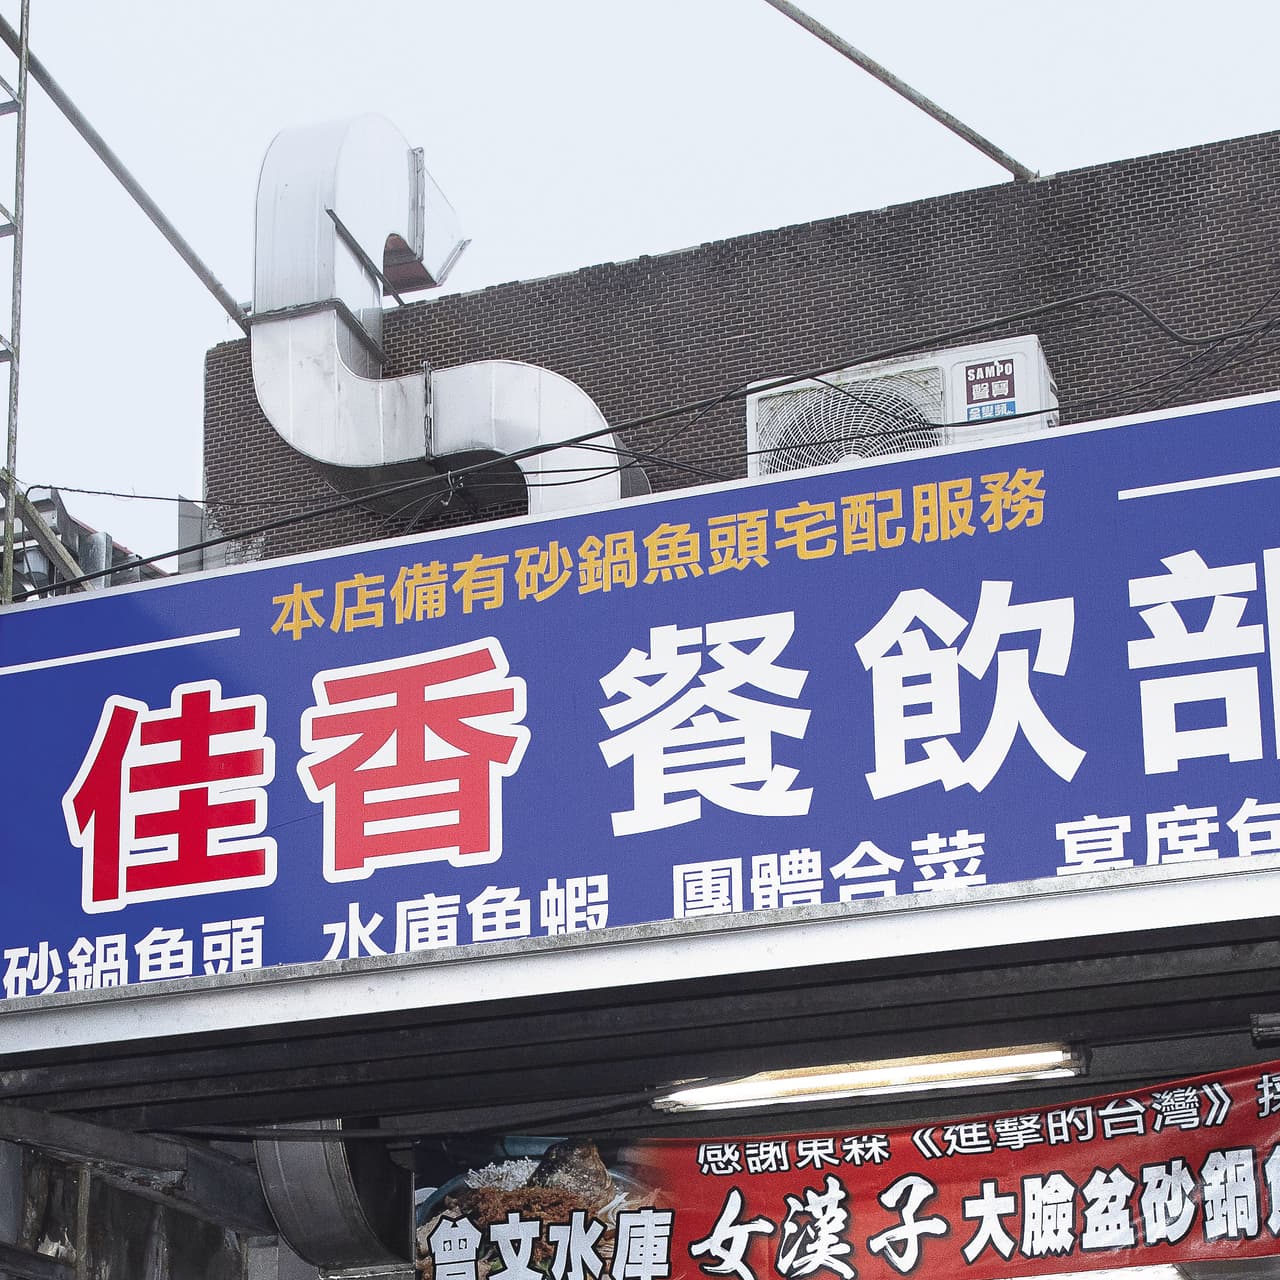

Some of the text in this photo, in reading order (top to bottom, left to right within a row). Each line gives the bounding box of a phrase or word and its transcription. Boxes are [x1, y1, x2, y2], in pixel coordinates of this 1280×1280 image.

[968, 362, 1012, 381] SAMPO
[271, 467, 1047, 641] 本店備有砂鍋魚頭宅配服務
[3, 916, 265, 999] 砂鍋魚頭
[322, 874, 609, 960] 水庫魚蝦
[673, 829, 987, 918] 團體合菜
